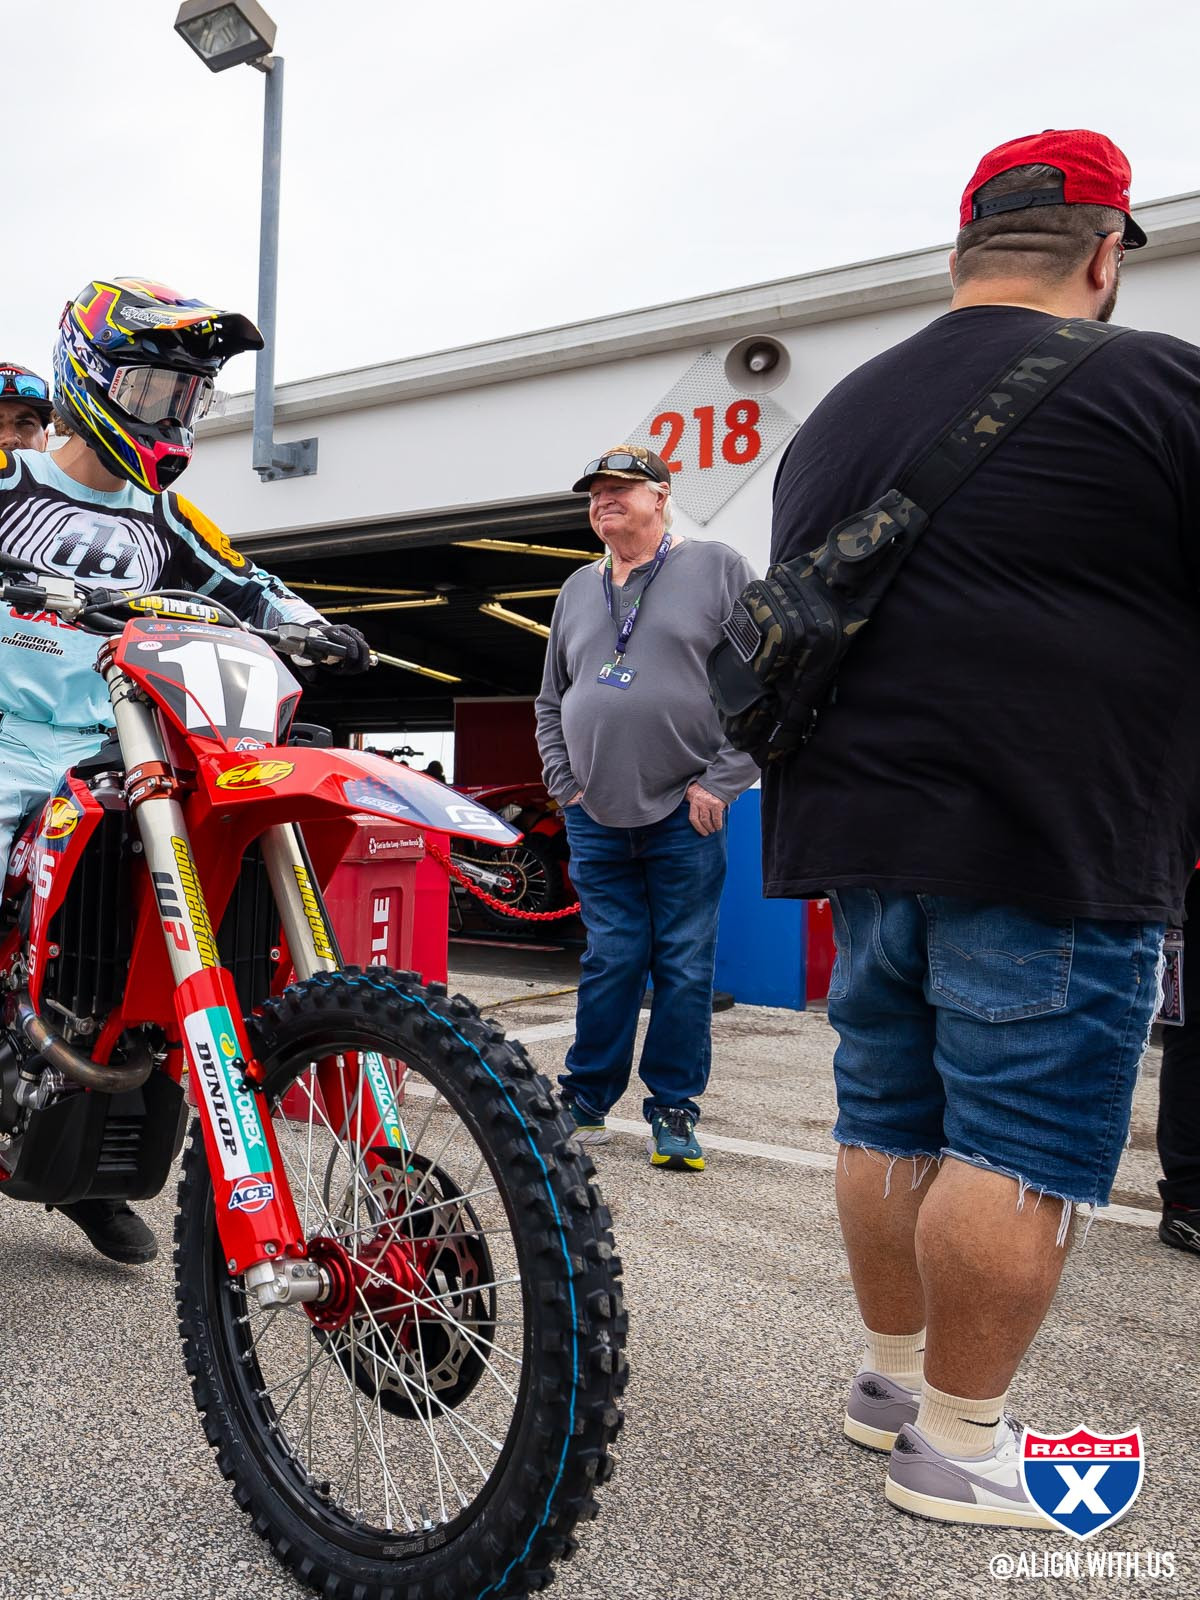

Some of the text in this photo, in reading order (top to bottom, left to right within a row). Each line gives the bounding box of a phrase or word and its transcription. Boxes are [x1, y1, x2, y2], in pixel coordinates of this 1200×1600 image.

[110, 369, 122, 395] OAKLEY
[650, 399, 761, 473] 218
[13, 632, 59, 647] Factory
[157, 640, 279, 733] 17
[216, 762, 296, 787] FMF
[151, 872, 191, 951] WP
[292, 865, 336, 961] Factory
[196, 1042, 238, 1156] DUNLOP
[230, 1186, 273, 1207] ACE
